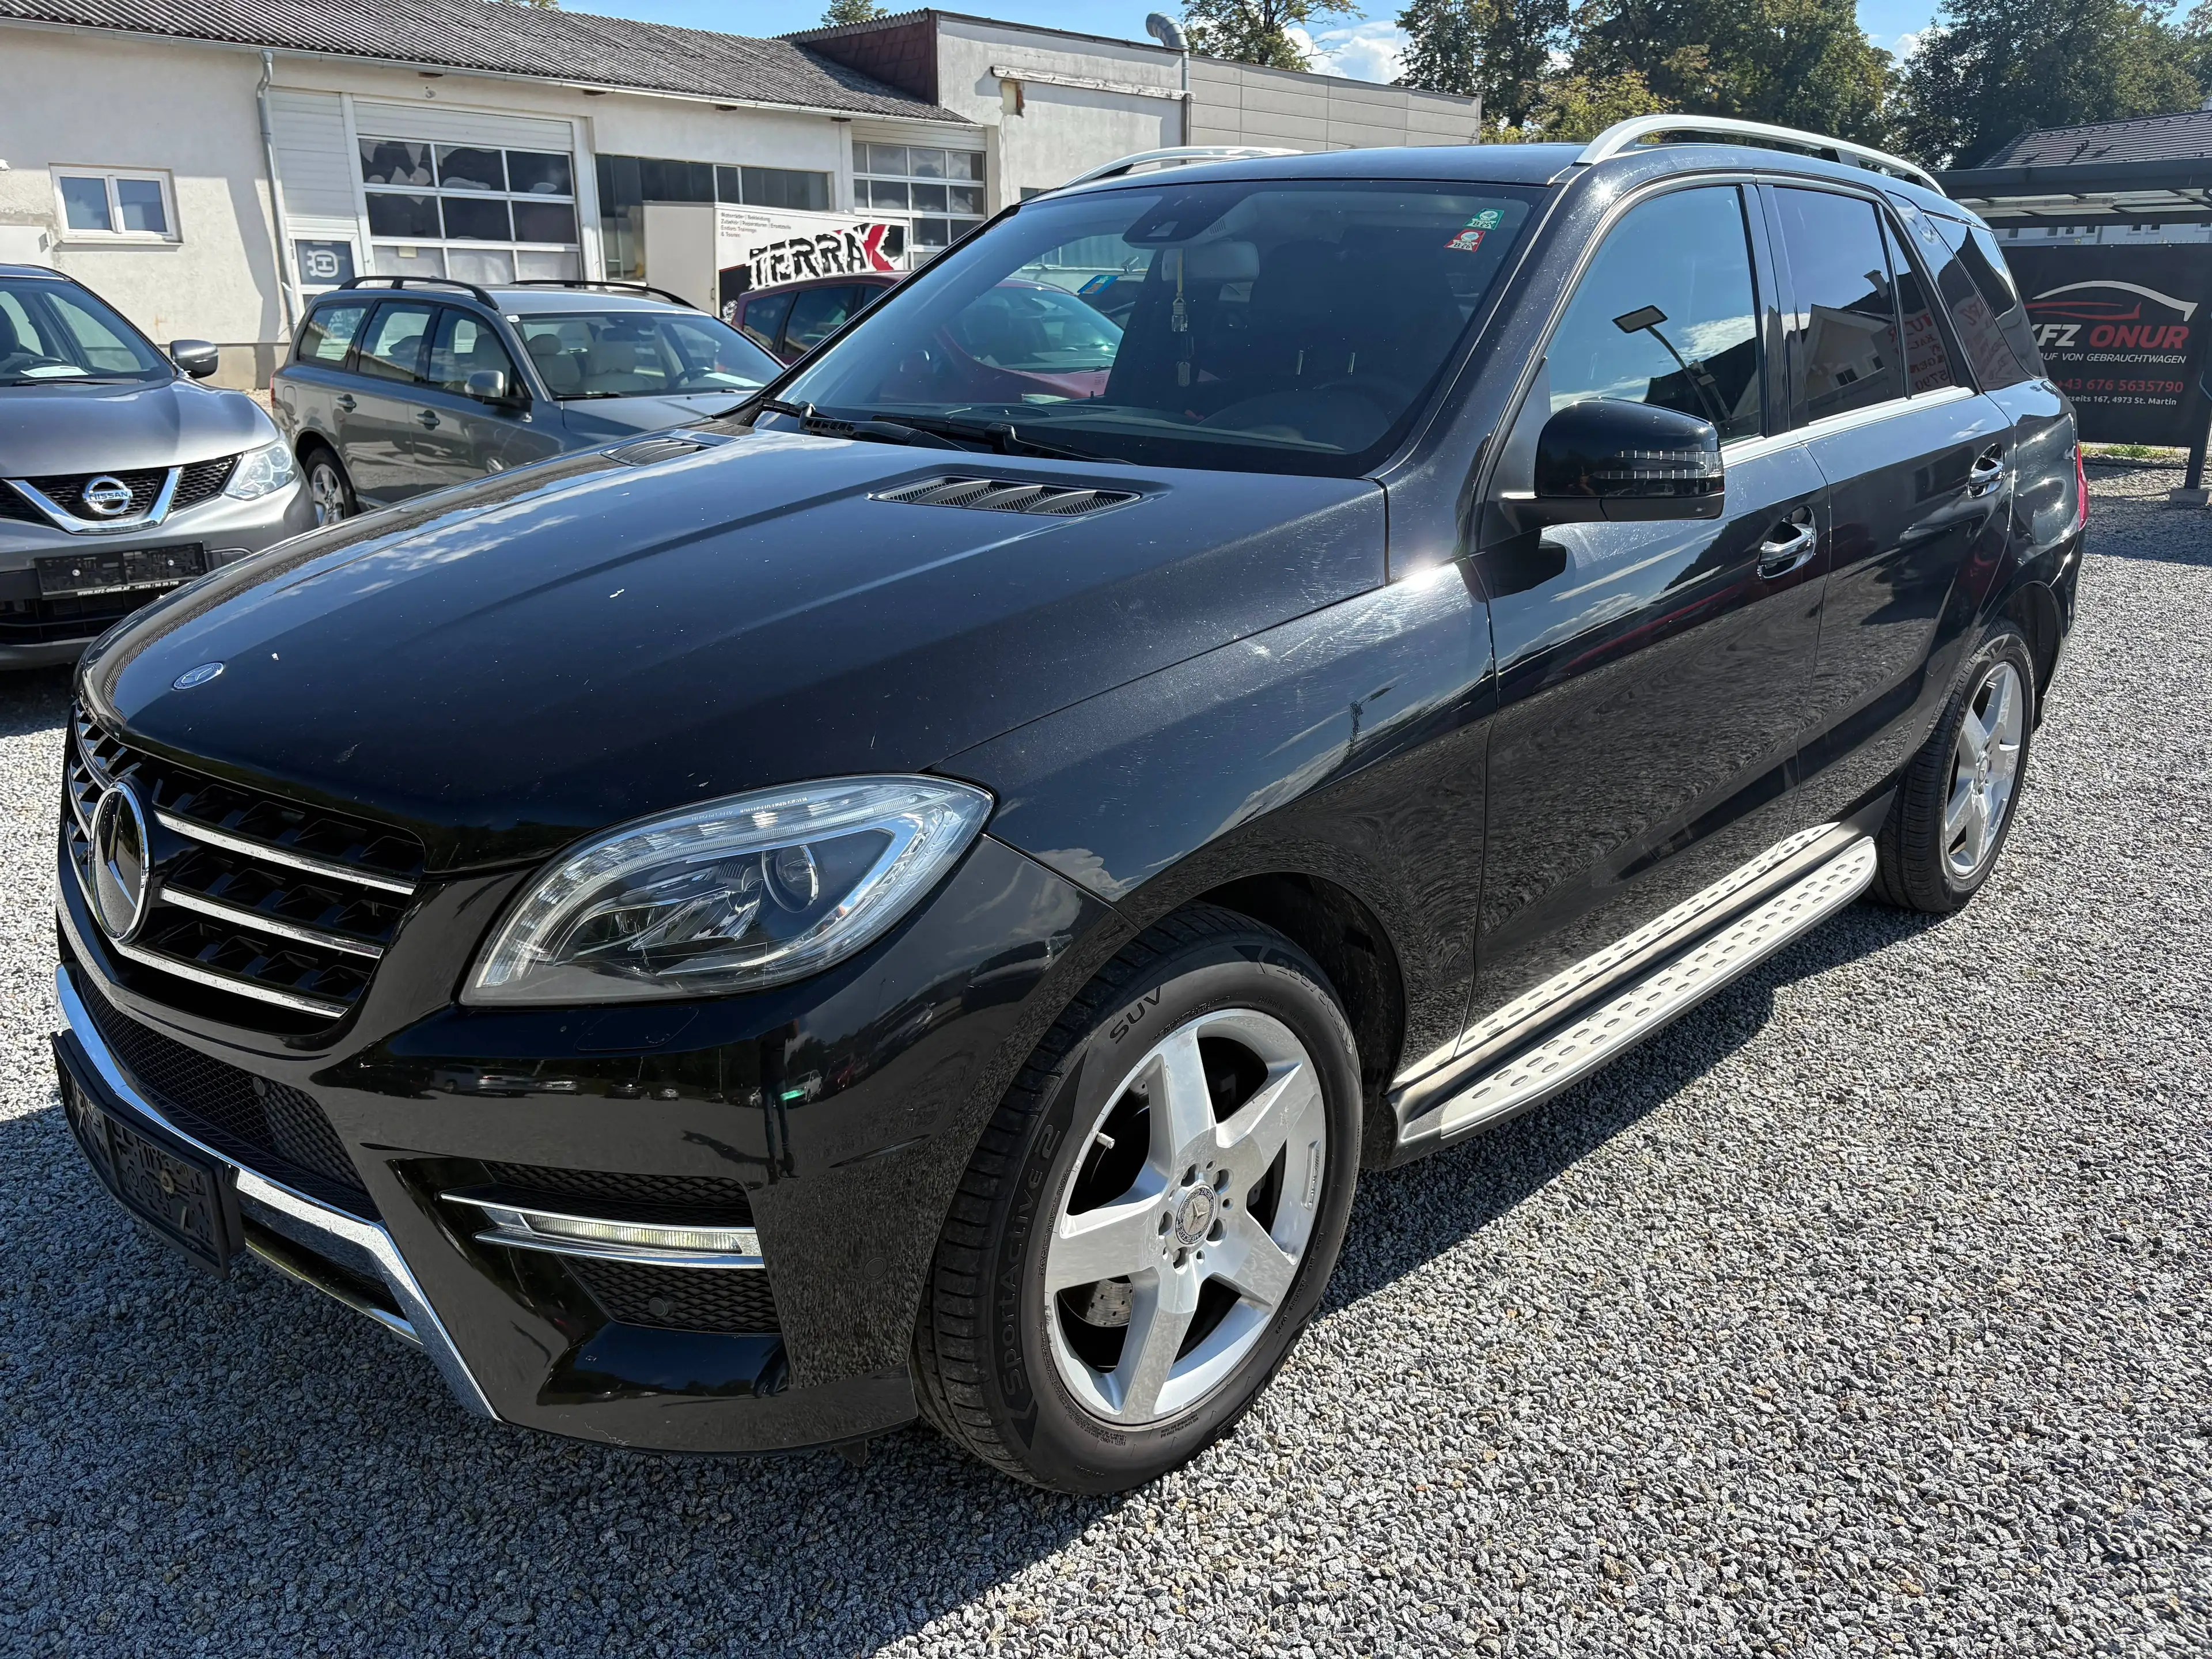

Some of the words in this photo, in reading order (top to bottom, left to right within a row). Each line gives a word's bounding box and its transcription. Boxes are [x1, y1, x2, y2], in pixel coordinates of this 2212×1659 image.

[2089, 324, 2189, 349] ONUR
[2062, 353, 2084, 361] VON
[2086, 353, 2187, 364] GEBRAUCHTWAGEN
[2086, 379, 2114, 391] 676
[2118, 380, 2184, 393] 5635790
[2094, 396, 2110, 404] 167,
[2148, 397, 2177, 406] Martin
[88, 491, 128, 501] NISSAN
[1109, 986, 1161, 1044] SUV
[1034, 1123, 1060, 1159] 2
